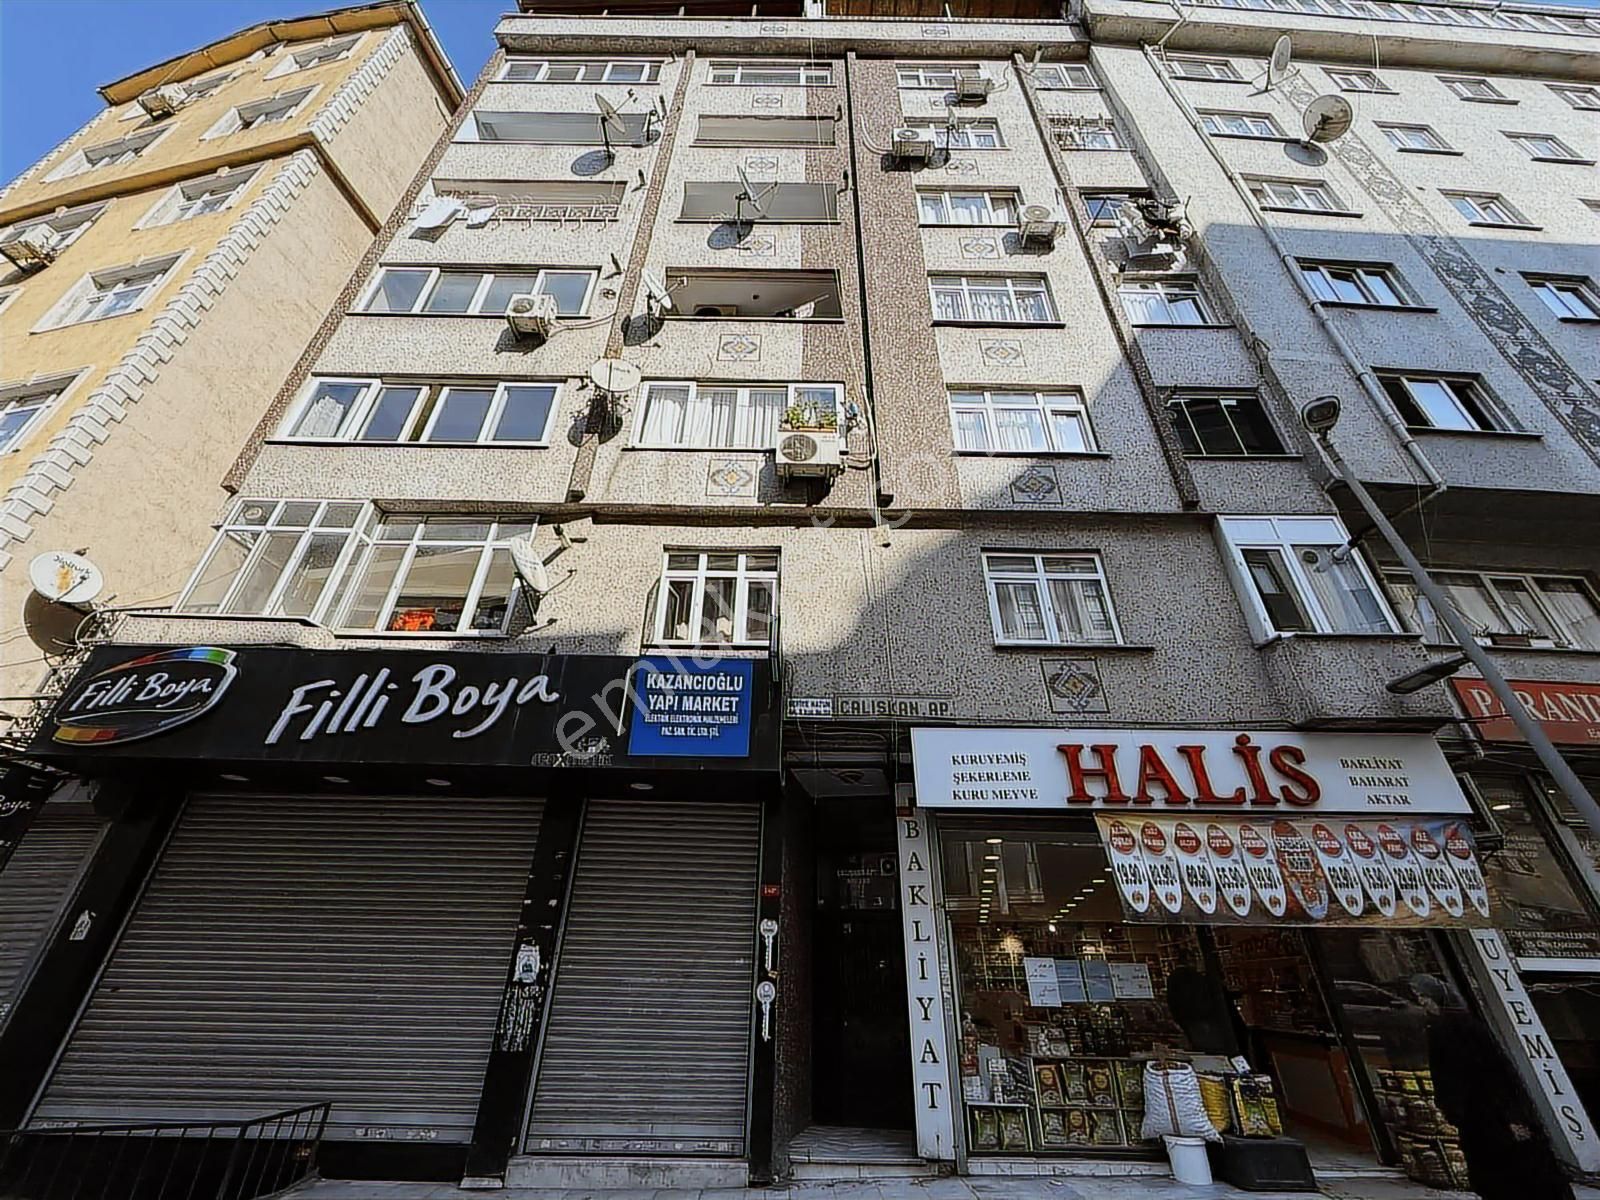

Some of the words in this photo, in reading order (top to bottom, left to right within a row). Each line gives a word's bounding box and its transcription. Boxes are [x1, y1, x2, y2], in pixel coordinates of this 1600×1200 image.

[646, 672, 743, 691] KAZANCIOĞLU
[69, 674, 138, 711] Filli
[136, 672, 212, 708] Boya
[265, 667, 399, 744] Filli
[402, 664, 559, 738] Boya
[648, 695, 679, 711] YAPI
[682, 696, 739, 712] MARKET
[1466, 687, 1600, 723] PRAN
[951, 752, 1027, 767] KURUYEMİŞ
[1340, 756, 1404, 770] BAKLİYAT
[952, 771, 1031, 784] ŞEKERLEME
[1056, 733, 1322, 806] HALİS
[1348, 775, 1410, 788] BAHARAT
[952, 788, 989, 800] KURU
[991, 788, 1038, 800] MEYVE
[1366, 794, 1411, 806] AKTAR
[905, 820, 941, 1109] BAKLİYAT
